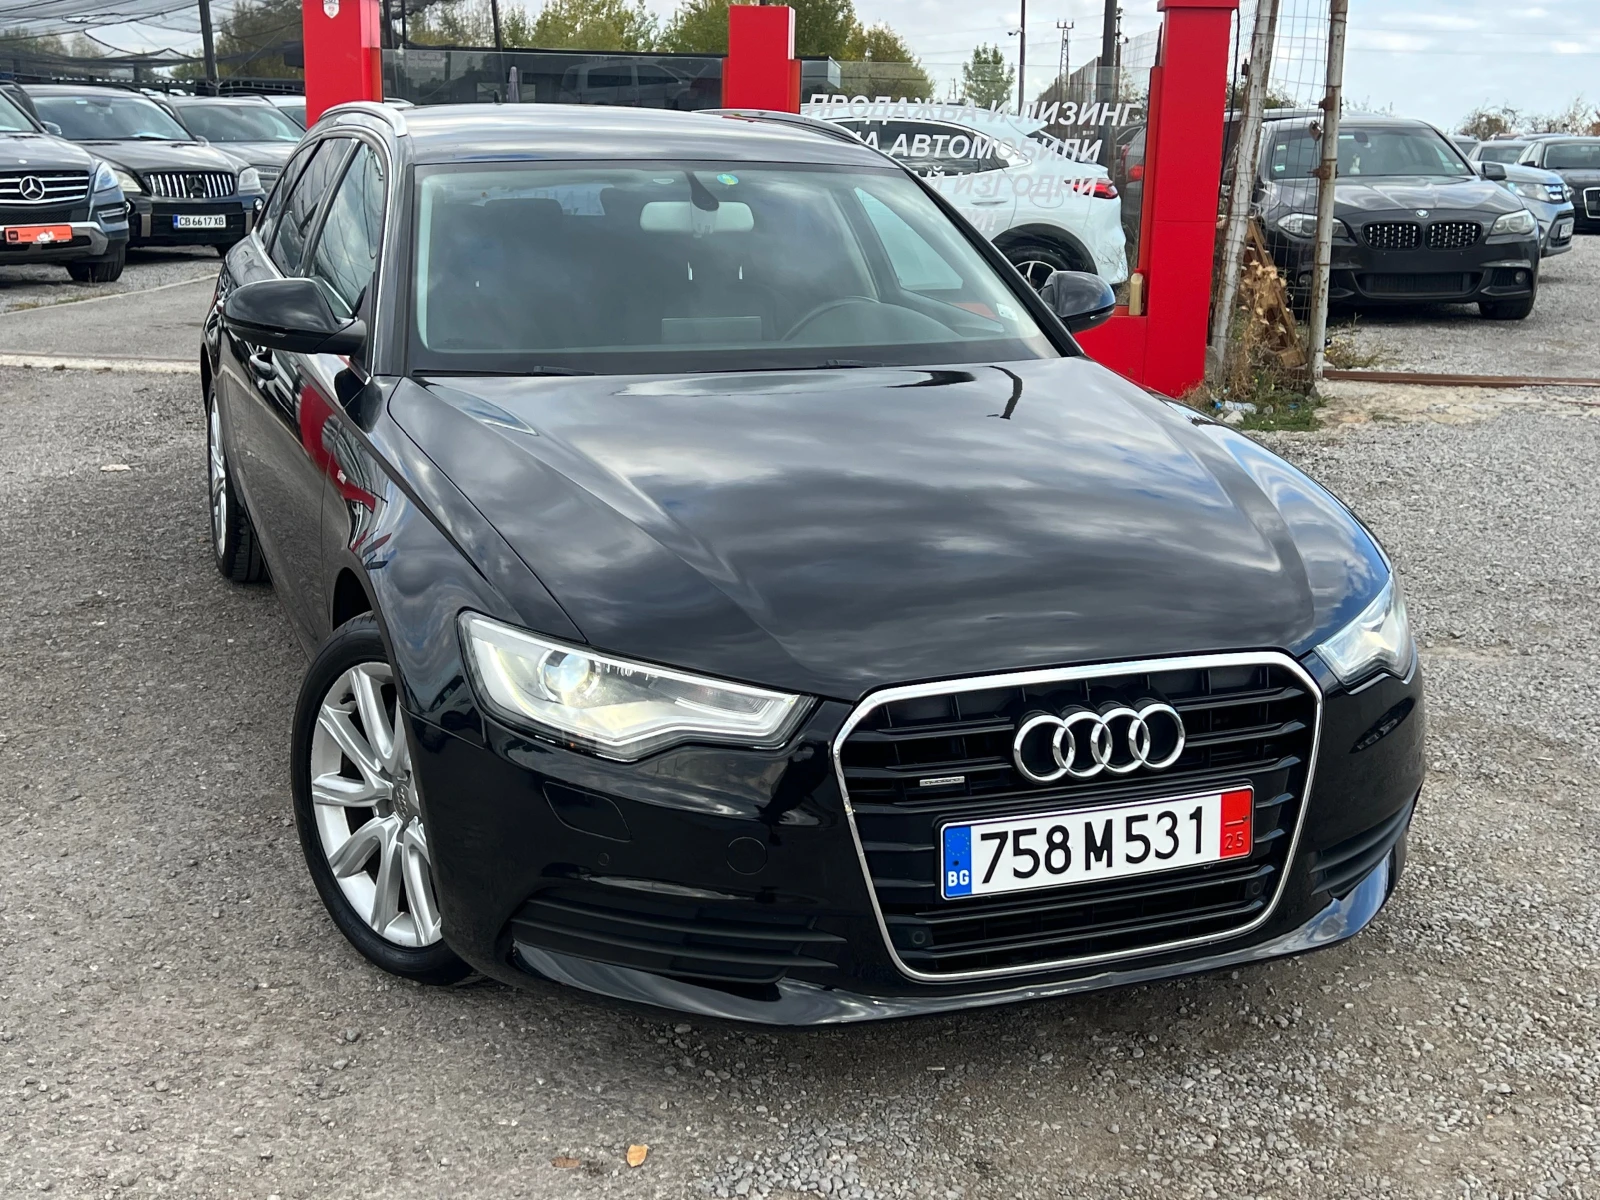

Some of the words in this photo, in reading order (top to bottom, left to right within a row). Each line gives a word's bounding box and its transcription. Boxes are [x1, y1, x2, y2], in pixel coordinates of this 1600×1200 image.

[807, 94, 977, 125] ПРОДАЖБА
[988, 100, 1009, 123] И
[1015, 101, 1142, 126] ЛИЗИНГ
[854, 131, 879, 149] А
[888, 133, 1103, 163] АВТОМОБИЛИ
[953, 172, 1099, 203] ИЗГОДНИ
[192, 216, 213, 226] 6617
[980, 824, 1072, 884] 758
[1125, 806, 1203, 864] 531
[1224, 830, 1244, 850] 25
[948, 869, 970, 886] BG
